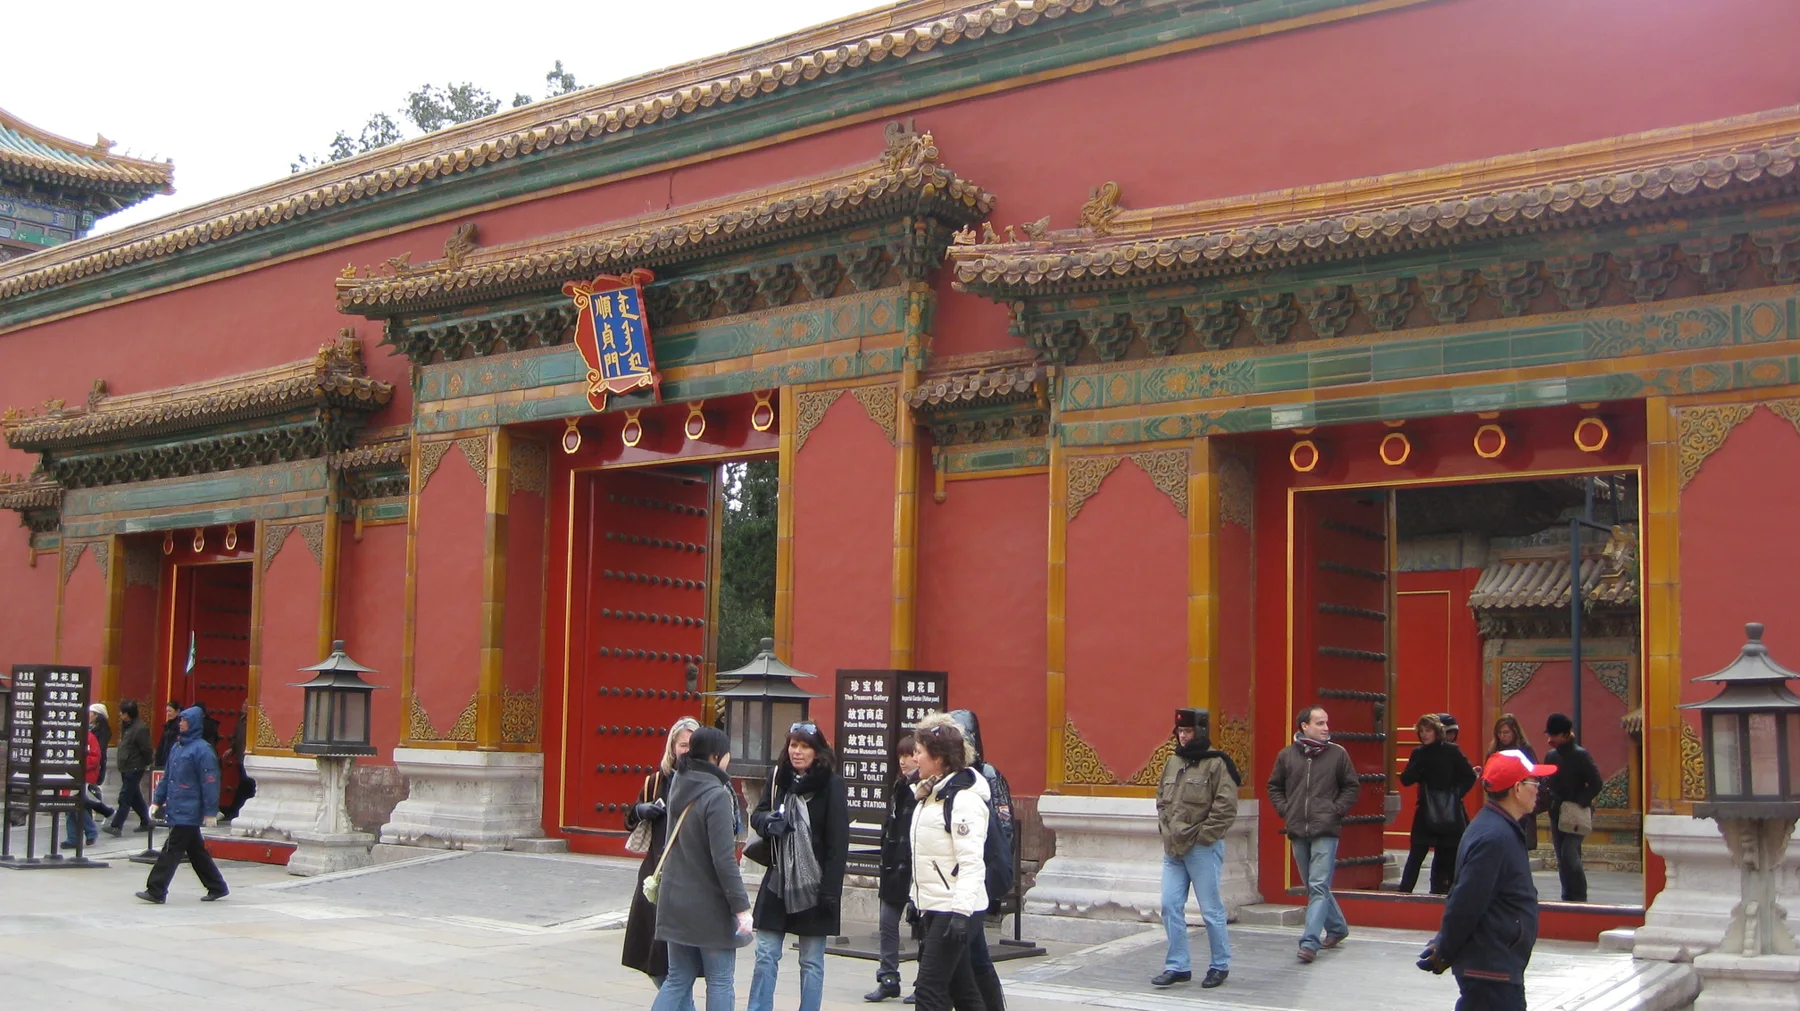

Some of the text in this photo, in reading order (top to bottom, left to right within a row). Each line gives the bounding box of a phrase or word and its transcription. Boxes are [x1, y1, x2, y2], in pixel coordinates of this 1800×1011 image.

[595, 295, 621, 378] 順貞門
[50, 672, 80, 682] 御花园
[850, 680, 884, 693] 珍宝馆
[907, 681, 936, 694] 御花园
[873, 694, 889, 703] Gallery
[48, 710, 77, 720] 坤宁宫
[847, 707, 884, 721] 故宫商店
[858, 721, 876, 729] Museum
[876, 722, 888, 730] Shop
[46, 730, 76, 739] 太和殿
[847, 733, 884, 747] 故宫礼品
[877, 748, 887, 756] Gifts
[859, 761, 888, 773] 卫生间
[863, 773, 884, 782] TOILET
[847, 786, 882, 799] 派出所
[862, 800, 887, 809] STATION
